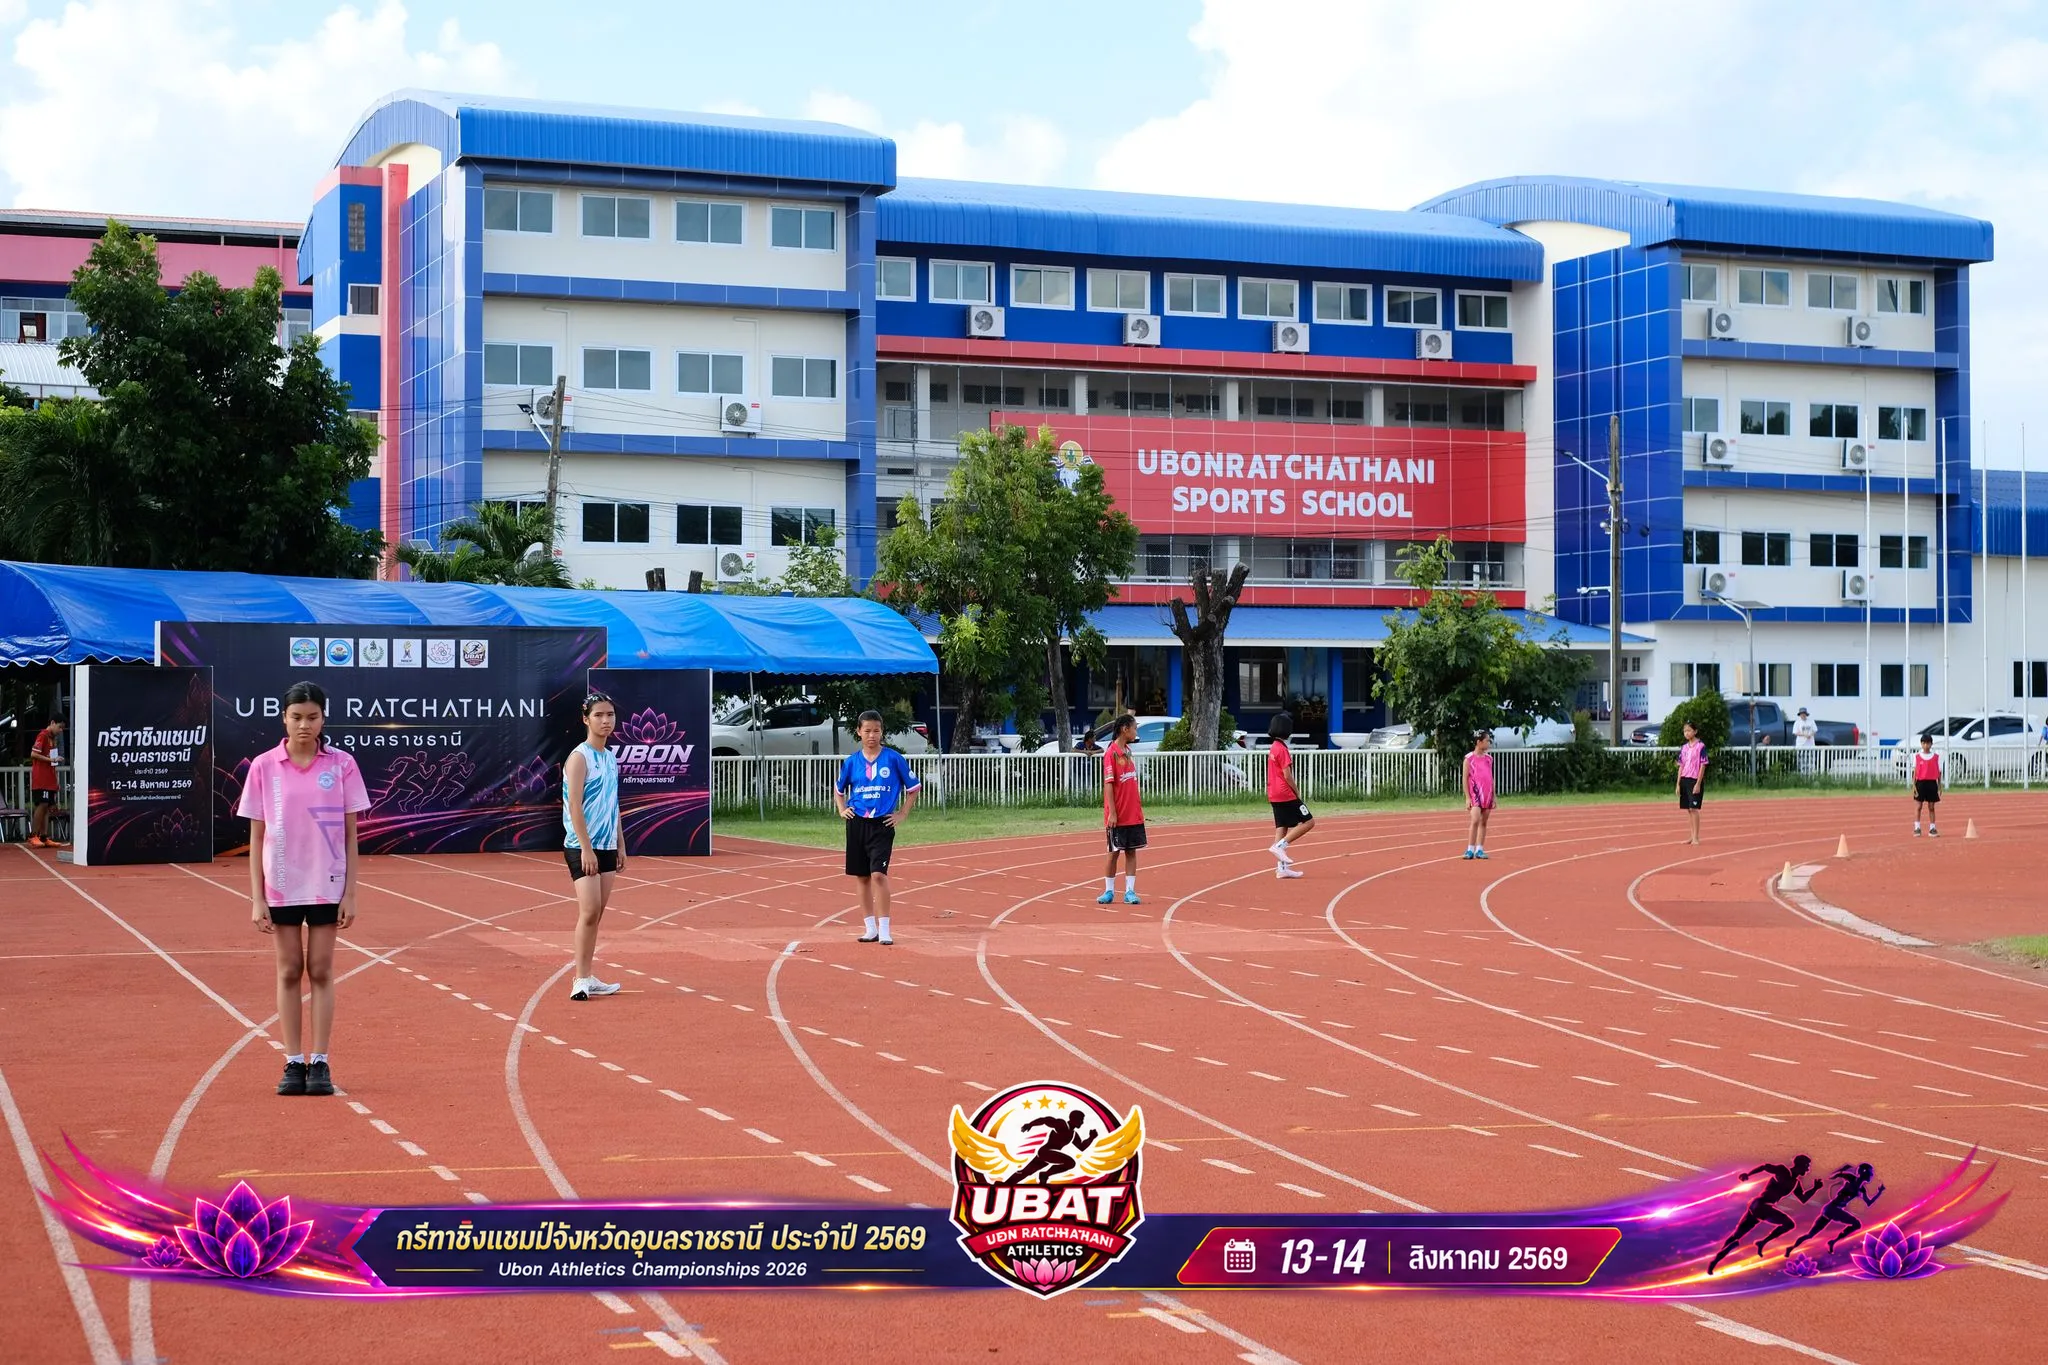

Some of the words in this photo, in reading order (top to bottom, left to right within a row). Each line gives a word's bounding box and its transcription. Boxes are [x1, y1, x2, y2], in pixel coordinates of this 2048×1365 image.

[1136, 448, 1436, 485] UBONRATCHATHANI
[1172, 485, 1287, 515] SPORTS
[1302, 489, 1413, 518] SCHOOL
[235, 697, 331, 718] UB
[346, 698, 545, 719] RATCHATHANI
[97, 725, 207, 747] กรีฑาชิงแชมป์
[110, 748, 191, 767] จ.อุบลราชธานี
[609, 744, 696, 764] UBON
[139, 779, 170, 790] สิงหาคม
[172, 780, 192, 788] 2569
